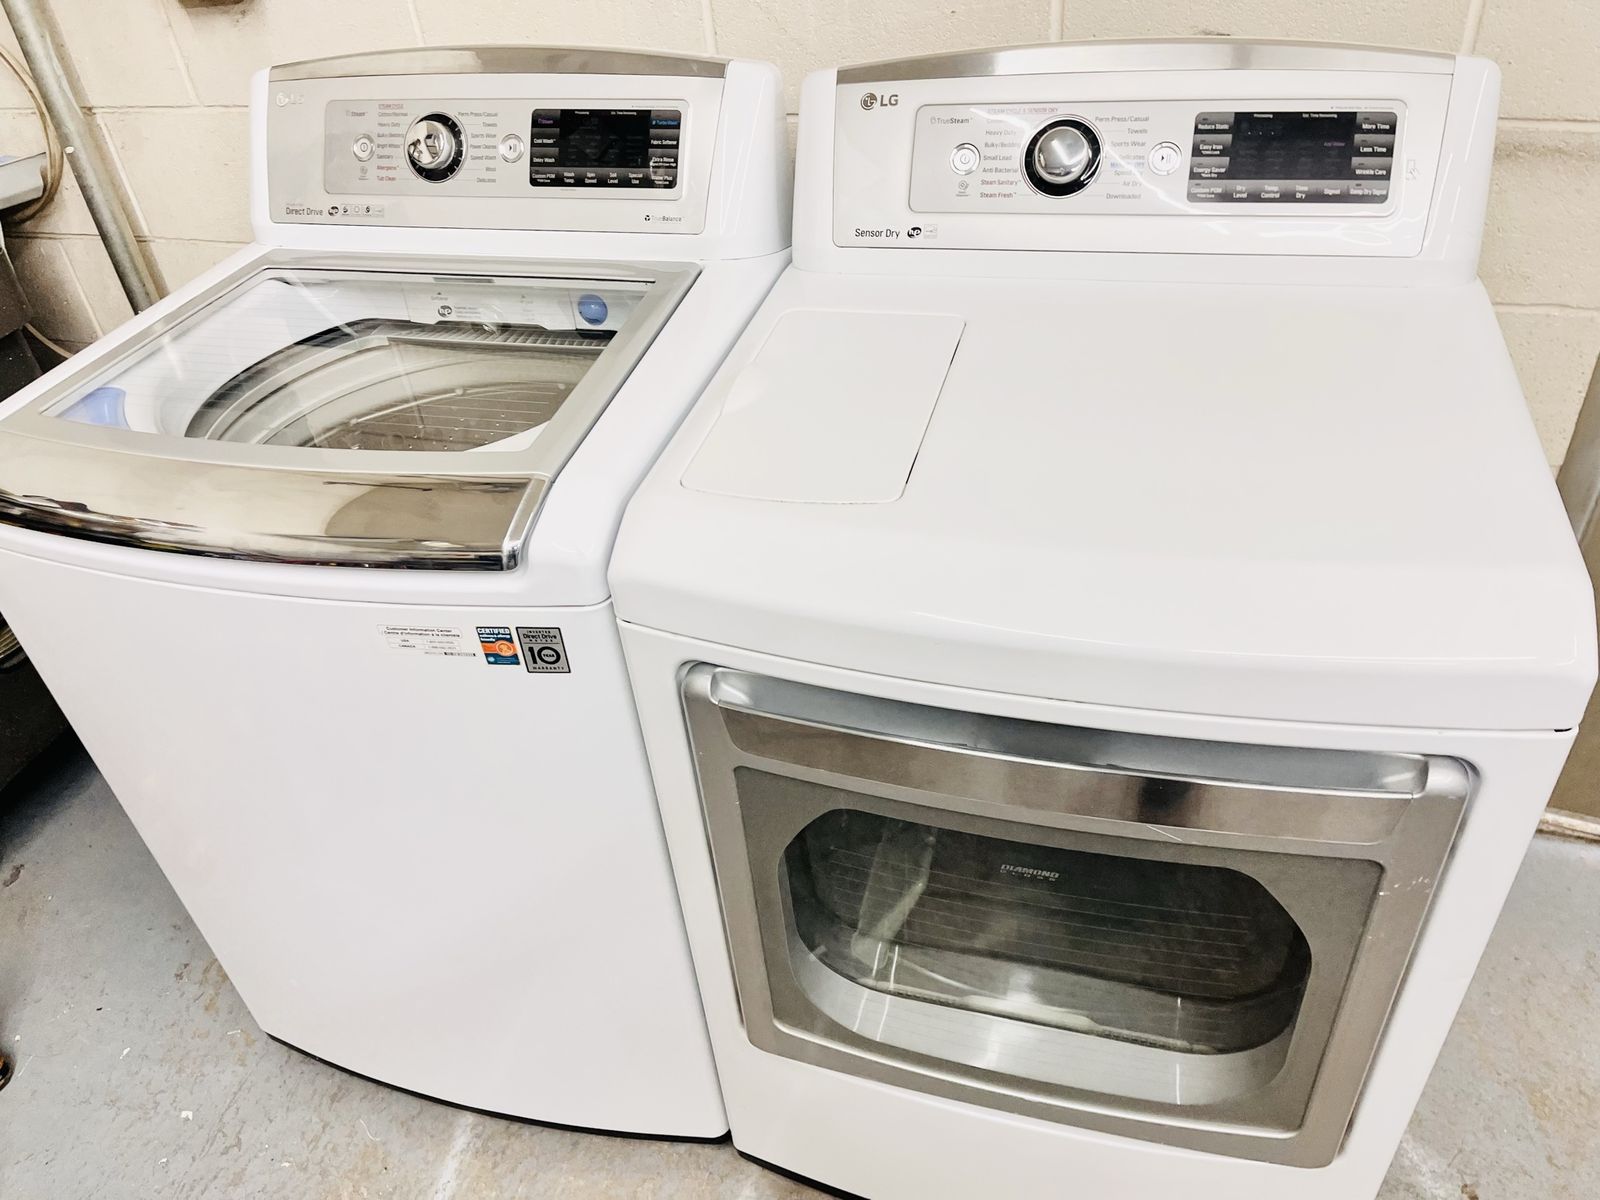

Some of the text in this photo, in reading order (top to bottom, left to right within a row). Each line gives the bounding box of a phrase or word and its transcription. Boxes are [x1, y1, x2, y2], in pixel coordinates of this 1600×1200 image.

[880, 94, 899, 107] LG
[286, 207, 324, 216] Direct Drive
[855, 228, 900, 239] Sensor Dry
[528, 646, 561, 665] 10
[1001, 864, 1060, 878] DIAMOND
